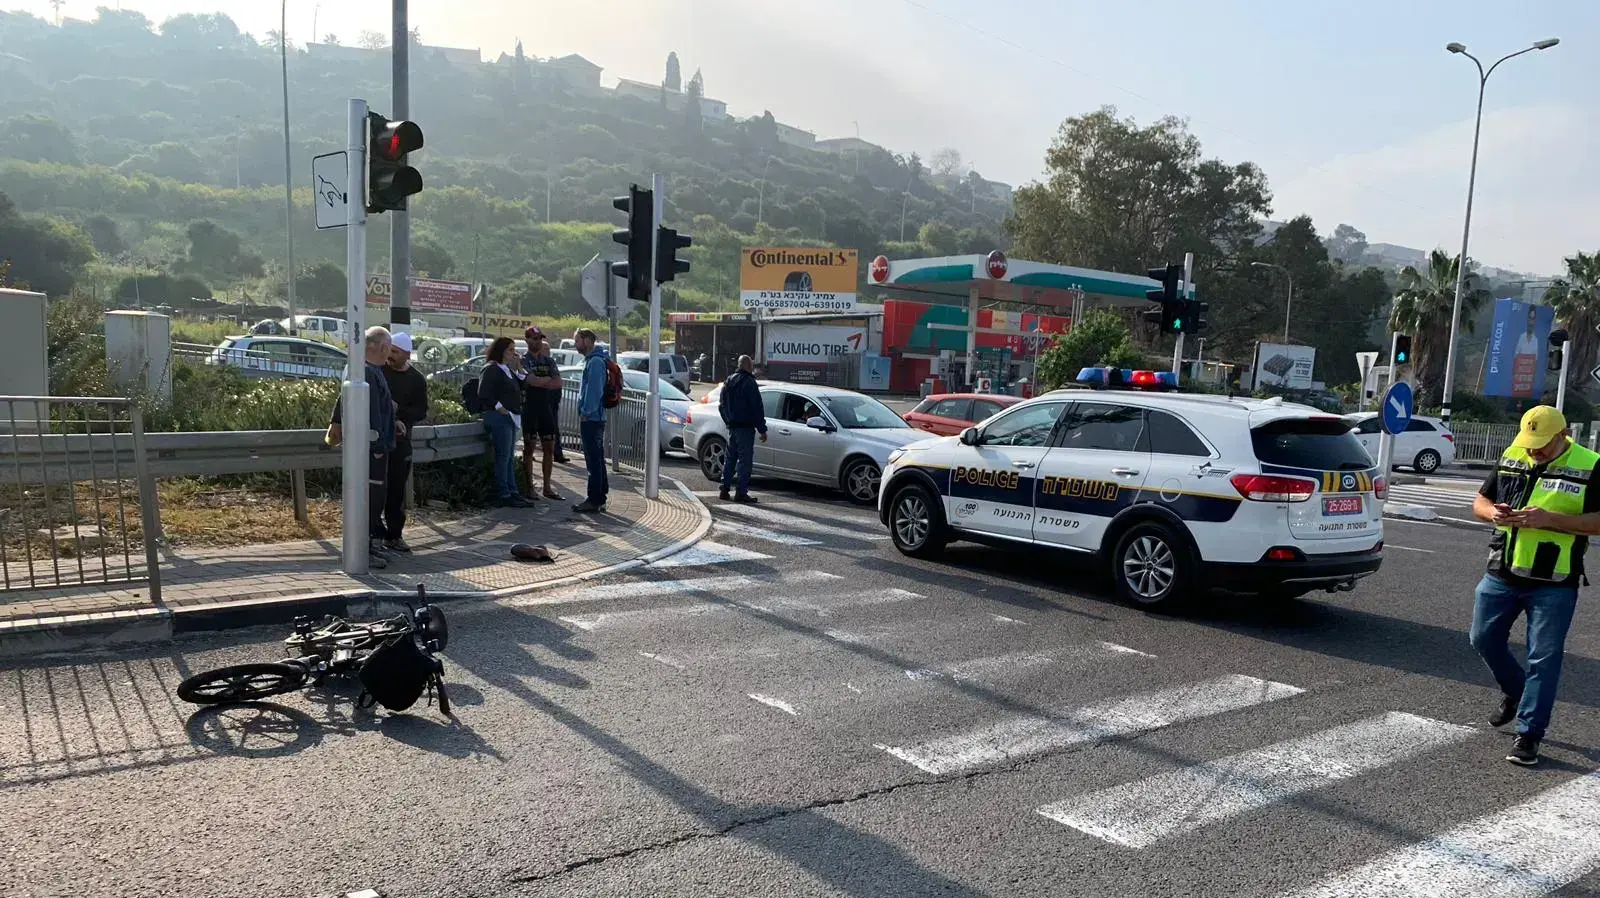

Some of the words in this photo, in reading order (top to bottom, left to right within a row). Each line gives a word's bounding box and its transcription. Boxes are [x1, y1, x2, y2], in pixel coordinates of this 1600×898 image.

[750, 249, 833, 268] Continental
[366, 277, 392, 296] VOL
[783, 292, 811, 300] עקיבא
[744, 299, 800, 308] 050-6658570
[800, 301, 851, 310] 04-6391019
[773, 341, 820, 356] KUMHO
[822, 343, 849, 357] TIRE
[955, 467, 1019, 489] POLICE
[1042, 475, 1119, 500] משטרה
[993, 507, 1031, 521] התנועה
[1039, 514, 1080, 529] משטרת
